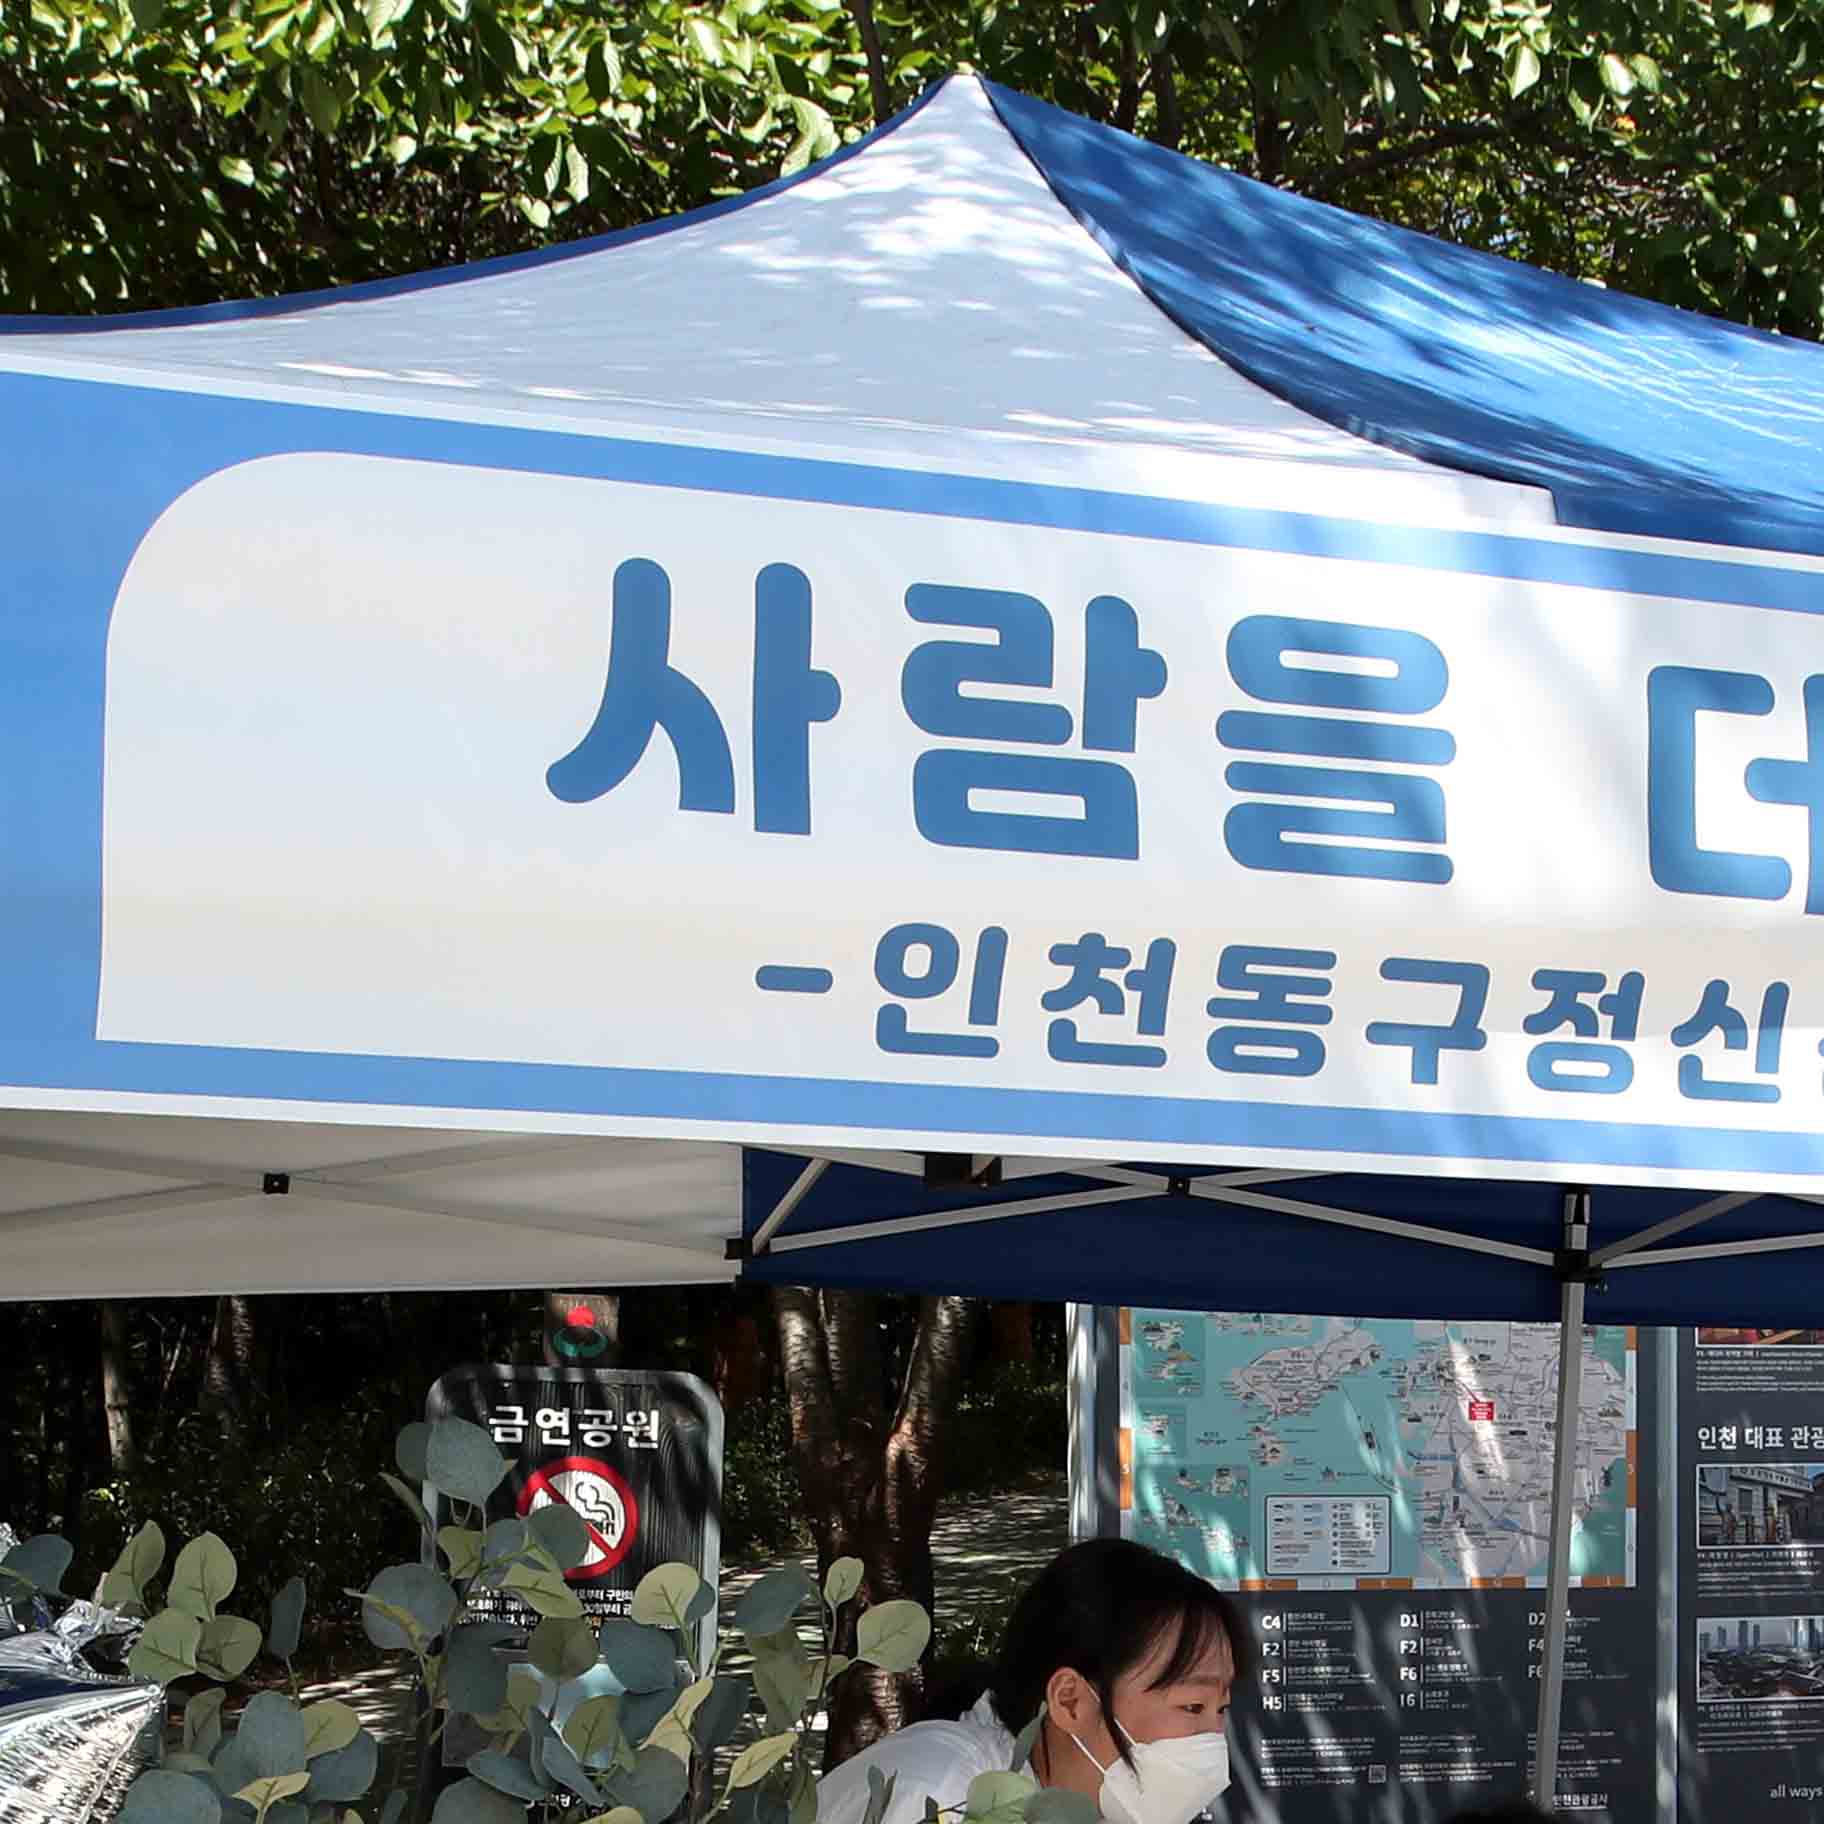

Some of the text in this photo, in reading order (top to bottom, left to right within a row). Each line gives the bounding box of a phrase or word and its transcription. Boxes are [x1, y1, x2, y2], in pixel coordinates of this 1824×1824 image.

[544, 555, 1456, 886] 사람을
[488, 1405, 660, 1450] 금연공원
[1698, 1425, 1737, 1451] 인천
[1744, 1425, 1785, 1450] 대표
[1261, 1615, 1282, 1631] C4
[1400, 1613, 1420, 1628] D1
[1528, 1613, 1547, 1627] D2
[1262, 1642, 1281, 1657] F2
[1400, 1640, 1418, 1655] F2
[1262, 1669, 1281, 1684] F5
[1400, 1666, 1418, 1681] F6
[1262, 1695, 1283, 1710] H5
[1770, 1784, 1788, 1799] all
[1789, 1785, 1824, 1801] ways
